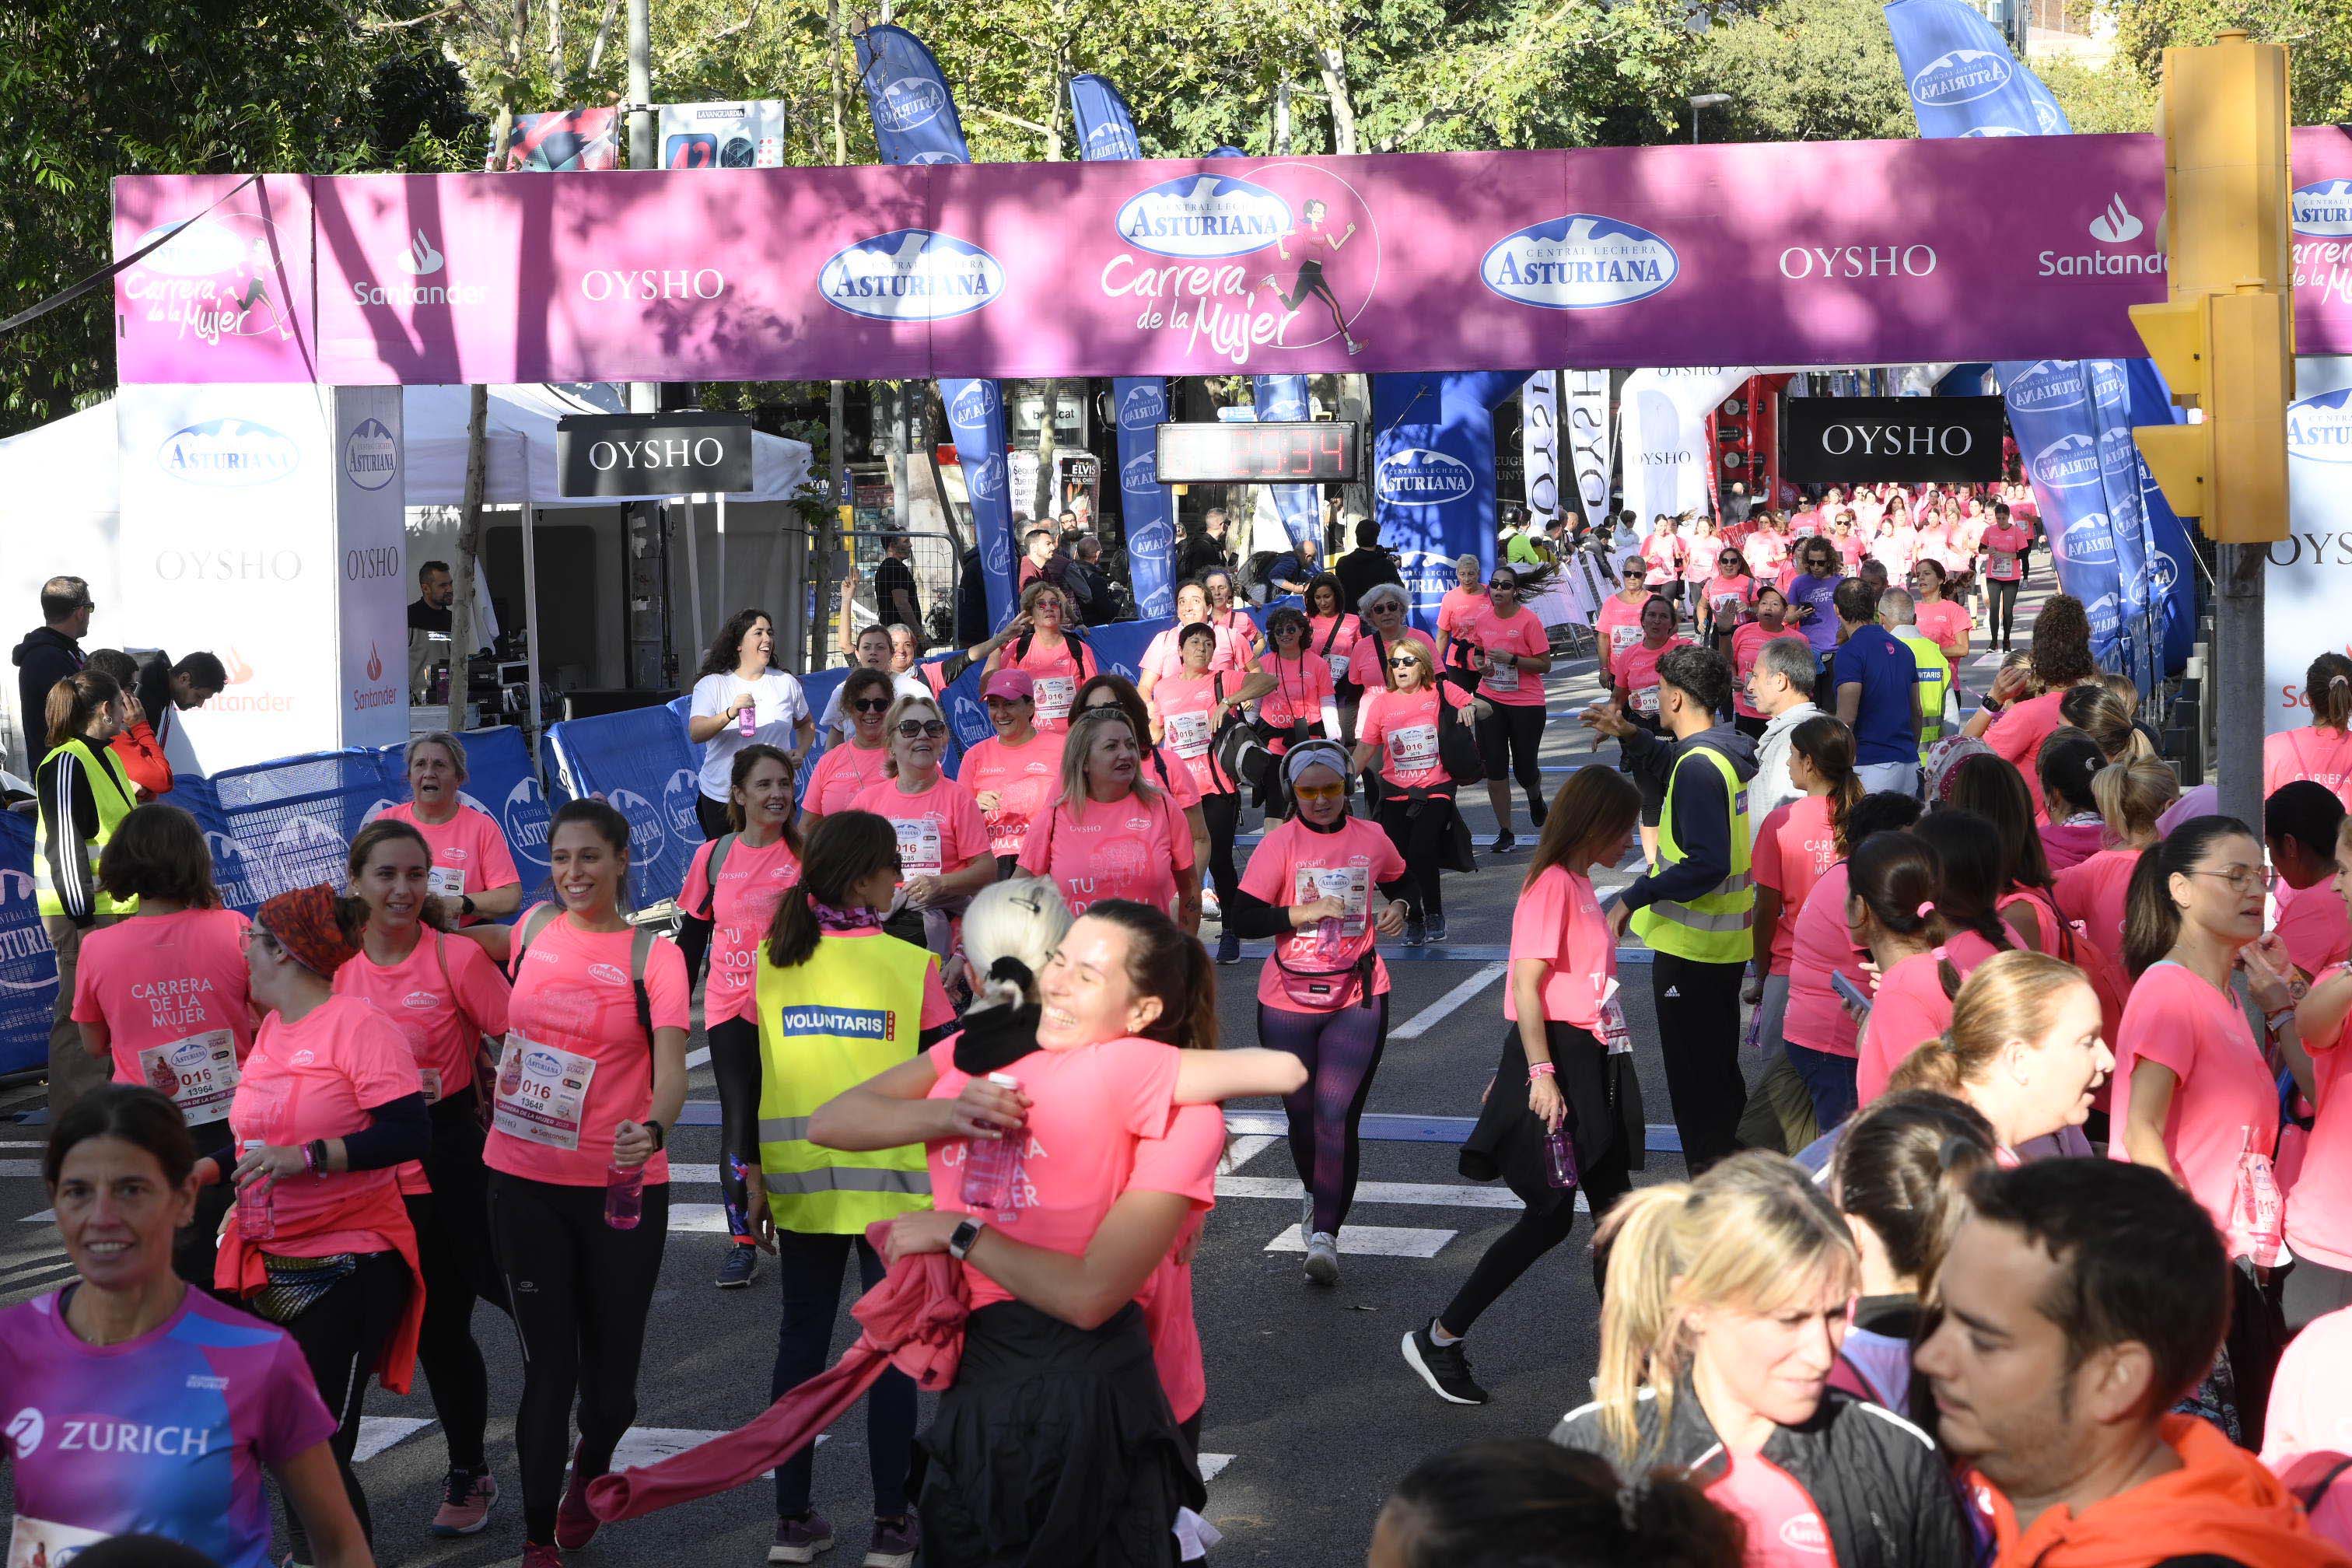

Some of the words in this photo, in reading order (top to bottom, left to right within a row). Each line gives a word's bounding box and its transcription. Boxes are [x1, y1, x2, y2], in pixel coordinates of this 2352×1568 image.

[1129, 206, 1277, 237] ASTURIANA
[1526, 246, 1587, 257] CENTRAL
[1594, 245, 1657, 255] LECHERA
[1779, 244, 1937, 279] OYSHO
[1101, 254, 1247, 298] Carrera
[1495, 250, 1663, 285] ASTURIANA
[2311, 265, 2325, 286] la
[124, 271, 216, 301] Carrera
[581, 268, 725, 302] OYSHO
[833, 264, 990, 297] ASTURIANA
[353, 282, 487, 306] Santander
[177, 297, 251, 346] Mujer
[1136, 300, 1164, 330] de
[1170, 299, 1189, 330] la
[1184, 291, 1301, 366] Mujer
[1822, 424, 1972, 456] OYSHO
[2287, 417, 2352, 446] ASTU
[169, 443, 289, 469] ASTURIANA
[348, 446, 395, 472] ASTURIANA
[589, 437, 724, 471] OYSHO
[1632, 450, 1692, 466] OYSHO
[1072, 464, 1097, 476] ELVIS
[1379, 471, 1467, 493] ASTURIANA
[155, 549, 303, 582] OYSHO
[347, 545, 398, 581] OYSHO
[353, 686, 397, 712] Santander
[1048, 692, 1064, 701] 016
[1178, 730, 1195, 739] 016
[1405, 743, 1423, 751] 016
[2294, 772, 2352, 785] CRRERA
[628, 824, 663, 845] URIANA
[1069, 824, 1102, 833] OYSHO
[1295, 858, 1326, 869] OYSHO
[1815, 852, 1831, 864] DE
[718, 870, 748, 880] OYSHO
[527, 948, 559, 964] OYSHO
[590, 966, 625, 985] ASTURIANA
[131, 977, 215, 999] CARRERA
[149, 996, 172, 1013] DE
[179, 994, 201, 1010] LA
[152, 1007, 206, 1028] MUJER
[784, 1013, 883, 1033] VOLUNTARIS
[174, 1050, 205, 1063] ASTURIANA
[180, 1068, 212, 1087] 016
[527, 1059, 562, 1076] ASTURIANA
[187, 1084, 213, 1097] 13964
[521, 1080, 551, 1100] 016
[520, 1097, 544, 1111] 13648
[58, 1421, 210, 1456] ZURICH
